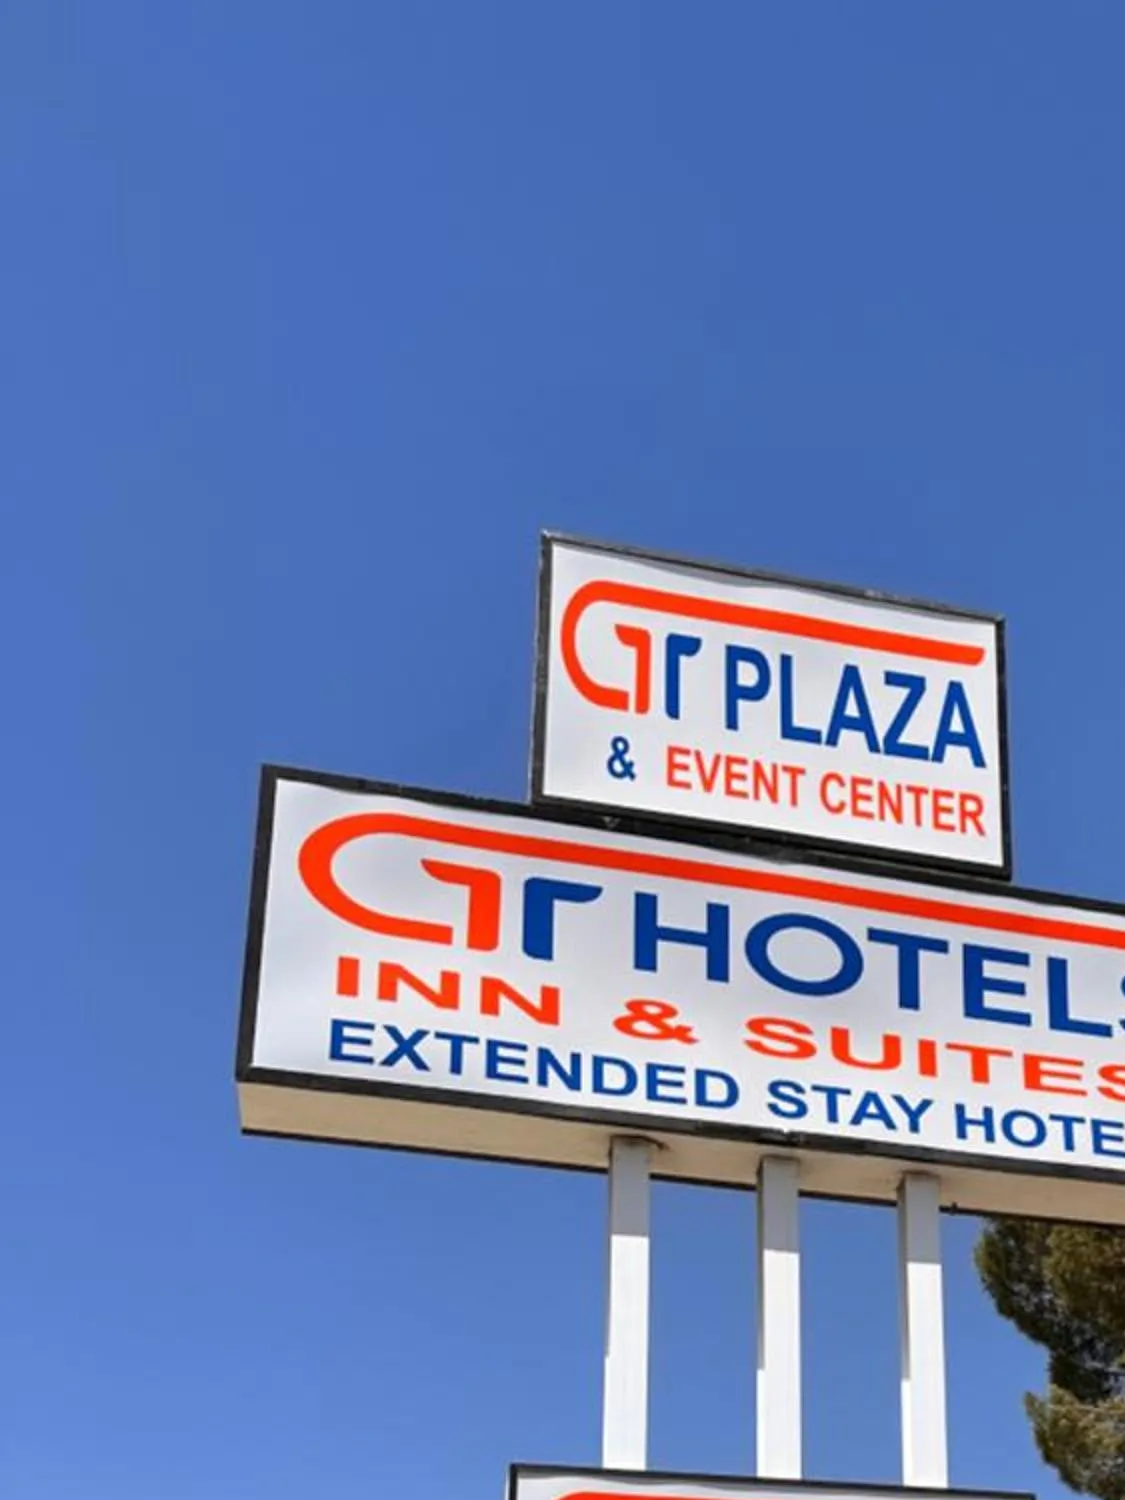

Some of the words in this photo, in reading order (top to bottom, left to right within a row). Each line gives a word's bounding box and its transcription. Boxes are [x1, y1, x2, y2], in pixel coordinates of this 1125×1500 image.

[722, 642, 987, 770] PLAZA
[605, 734, 637, 782] &
[665, 744, 806, 808] EVENT
[818, 770, 986, 837] CENTER
[335, 953, 562, 1027] INN
[612, 997, 697, 1046] &
[328, 1018, 742, 1112] EXTENDED
[766, 1078, 934, 1136] STAY
